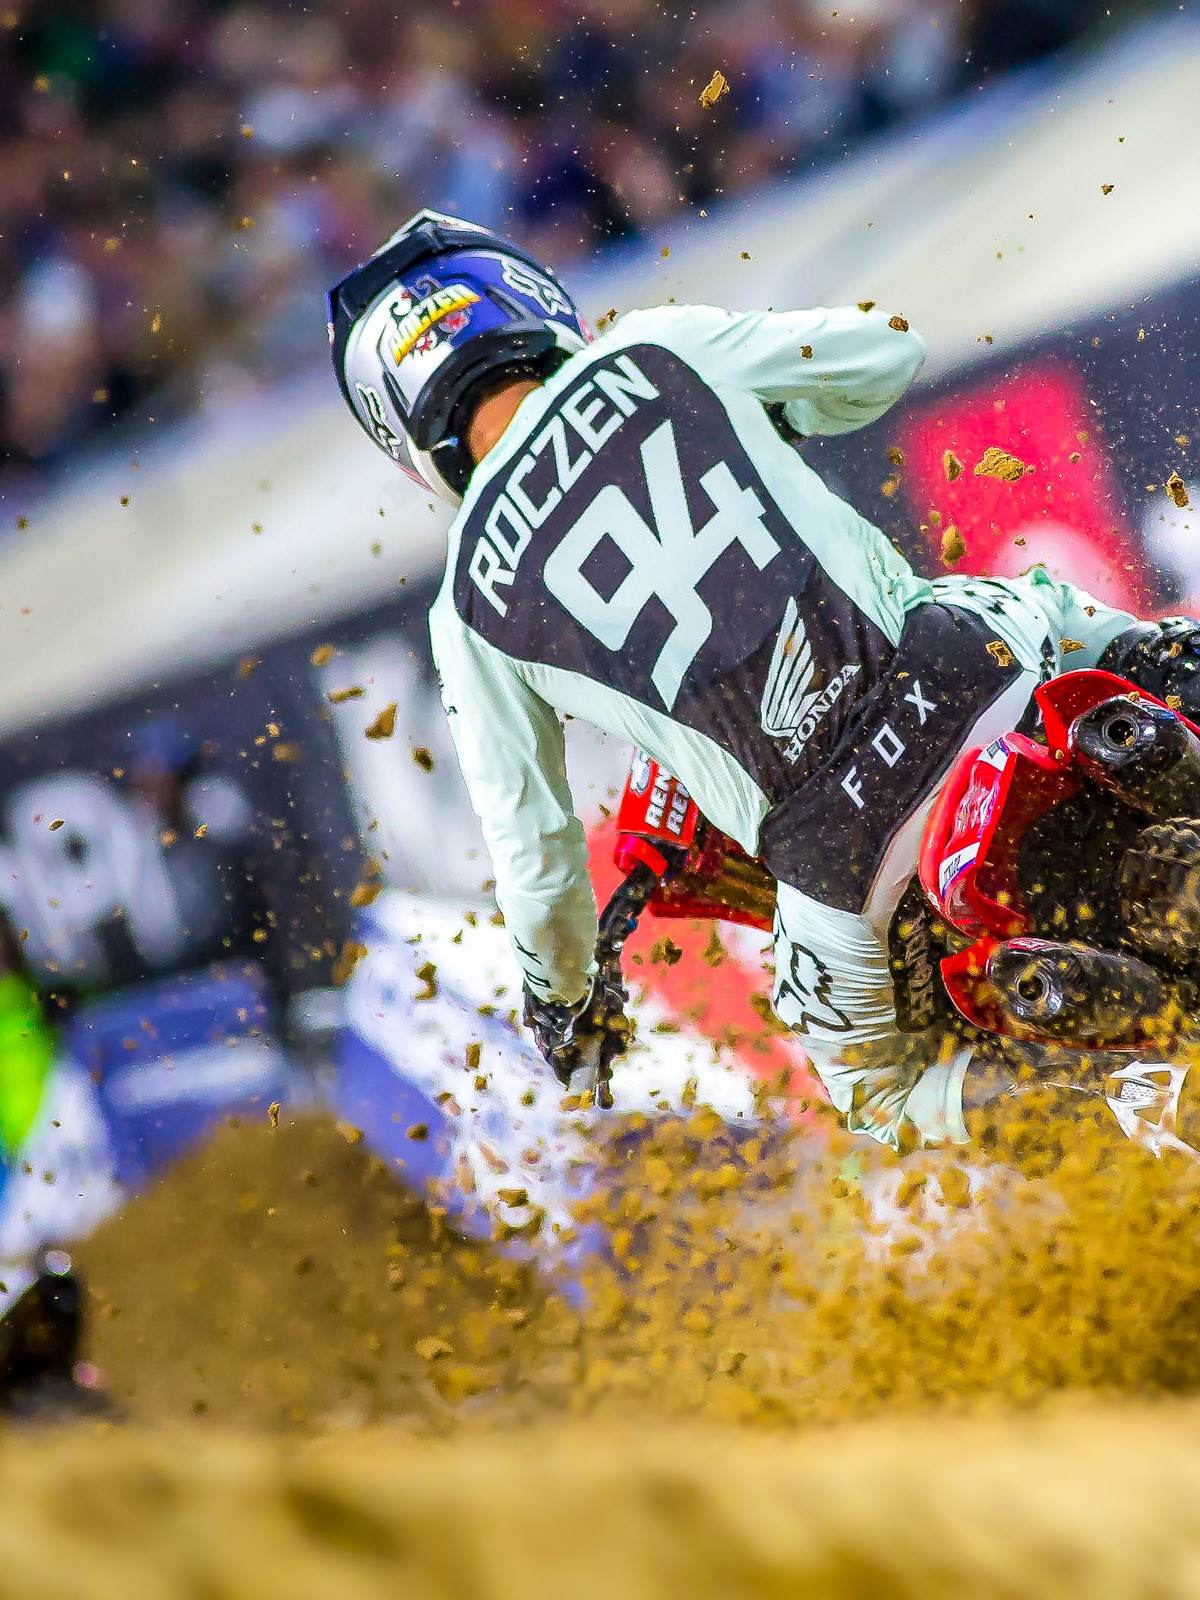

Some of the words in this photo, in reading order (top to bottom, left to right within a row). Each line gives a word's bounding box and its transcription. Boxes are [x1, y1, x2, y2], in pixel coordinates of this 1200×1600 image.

[467, 354, 661, 617] ROCZEN
[542, 419, 782, 712] 94
[782, 664, 862, 766] HONDA
[840, 679, 938, 809] FOX
